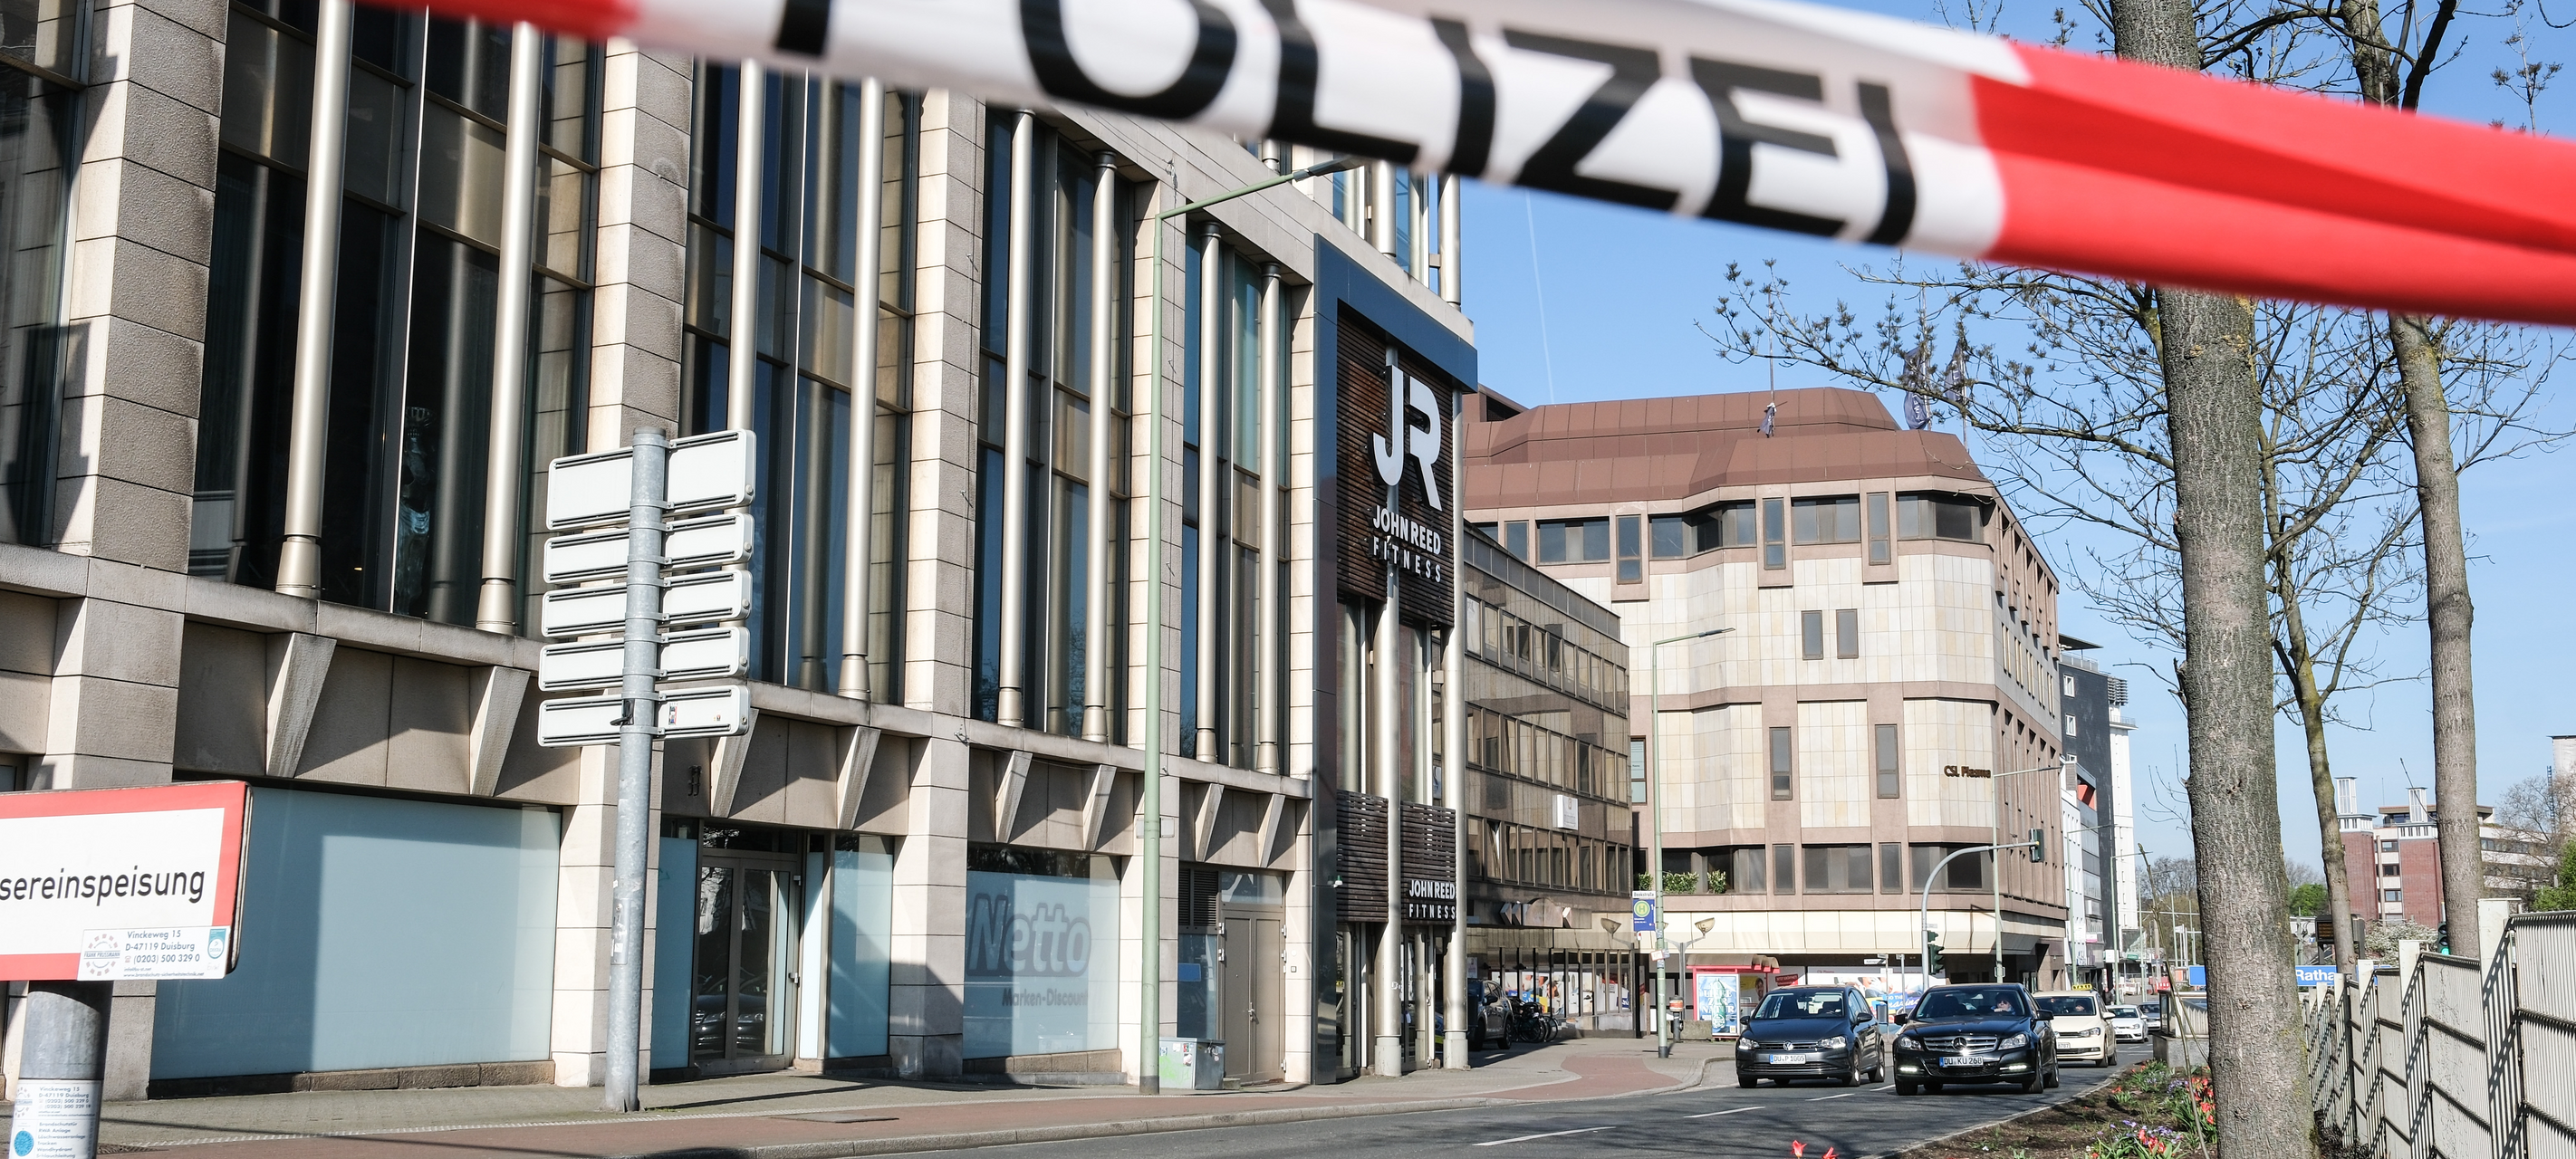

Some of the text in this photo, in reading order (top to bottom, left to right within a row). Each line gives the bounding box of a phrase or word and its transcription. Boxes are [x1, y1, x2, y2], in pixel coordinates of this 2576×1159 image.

[774, 0, 1922, 246] OLIZEI
[1370, 364, 1442, 512] JR
[1372, 504, 1442, 556] JOHN REED
[1372, 535, 1442, 584] FITNESS
[1944, 765, 1991, 779] CSL Plasma
[0, 865, 205, 906] sereinspeisung
[1408, 879, 1456, 899] JOHN REED
[1408, 903, 1456, 920] FITNESS
[127, 929, 181, 941] Vinckeweg 15
[966, 893, 1092, 978] Netto
[125, 942, 196, 952] D-47119 Duisburg
[133, 953, 200, 965] (0203) 500 329 0
[1944, 1057, 1954, 1065] DU
[1956, 1057, 1967, 1065] KU
